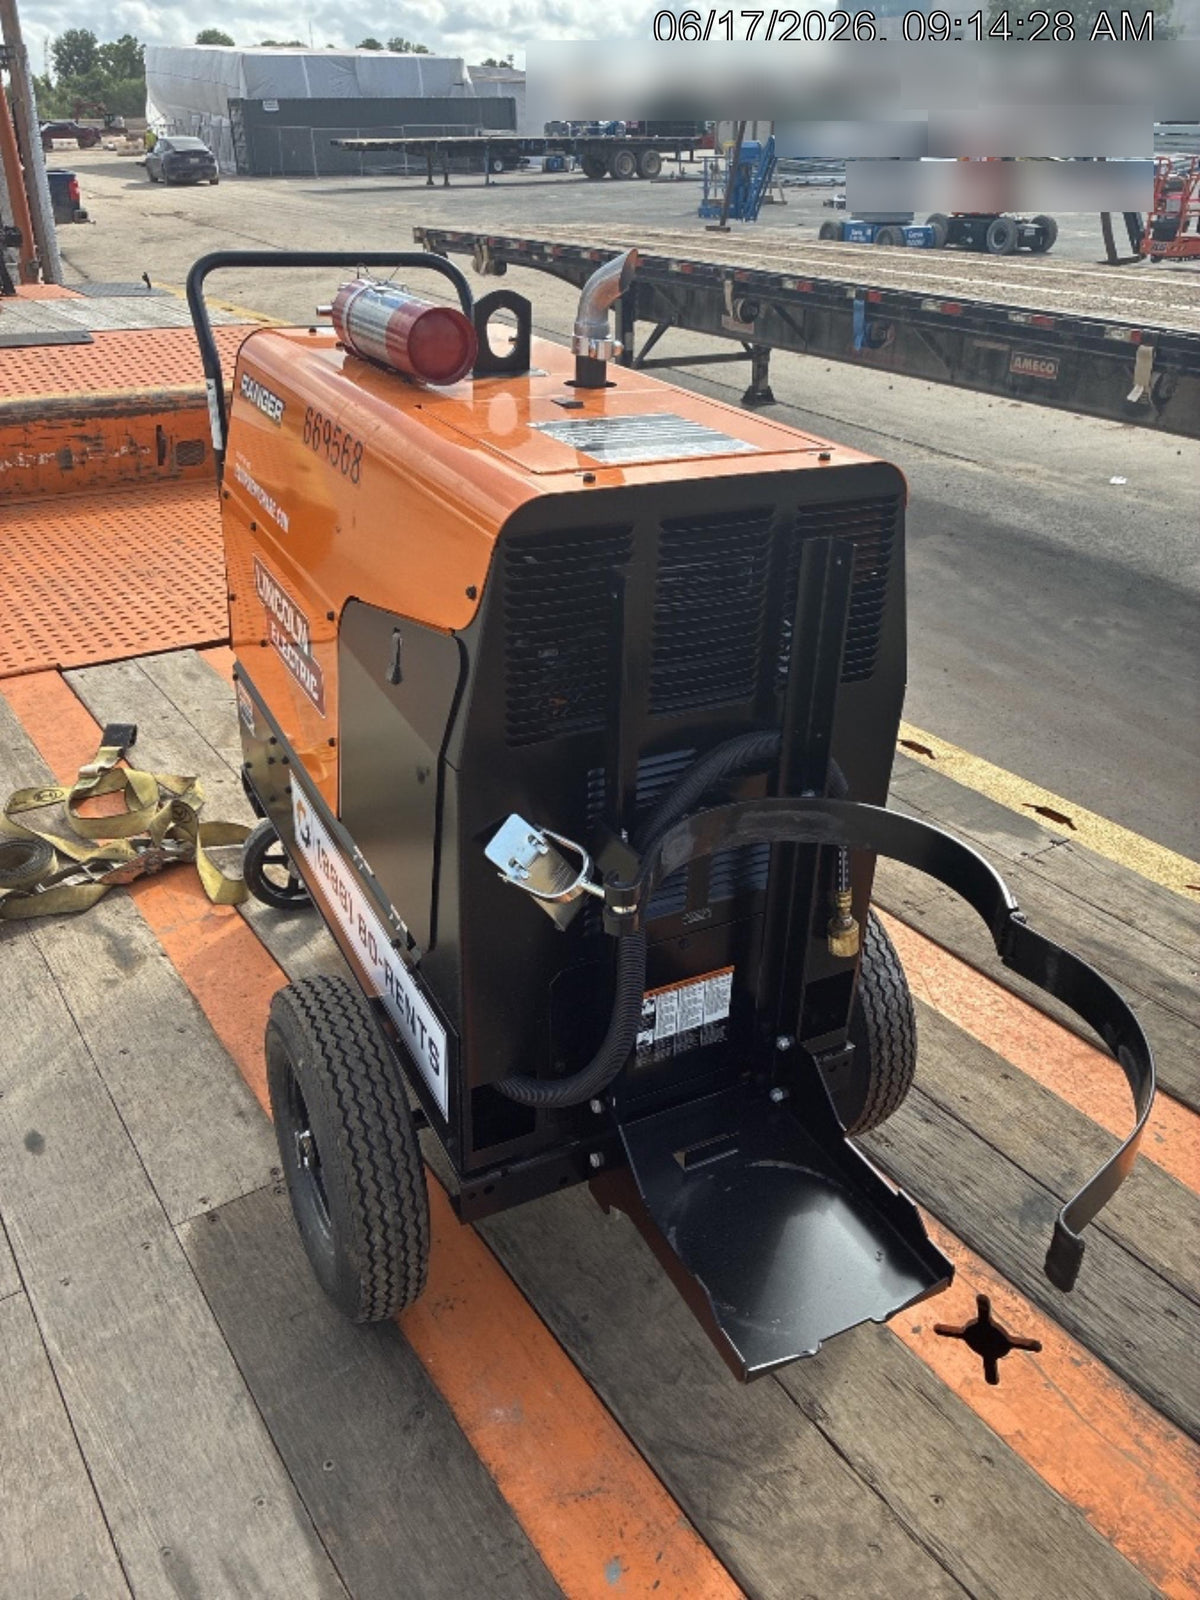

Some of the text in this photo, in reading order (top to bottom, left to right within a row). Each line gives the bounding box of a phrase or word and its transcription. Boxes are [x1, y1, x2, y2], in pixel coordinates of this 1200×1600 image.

[240, 373, 285, 424] RANGER
[1014, 356, 1055, 374] AMECO
[303, 406, 364, 485] 669568
[255, 563, 309, 656] LINCOLN
[270, 619, 320, 702] ELECTRIC
